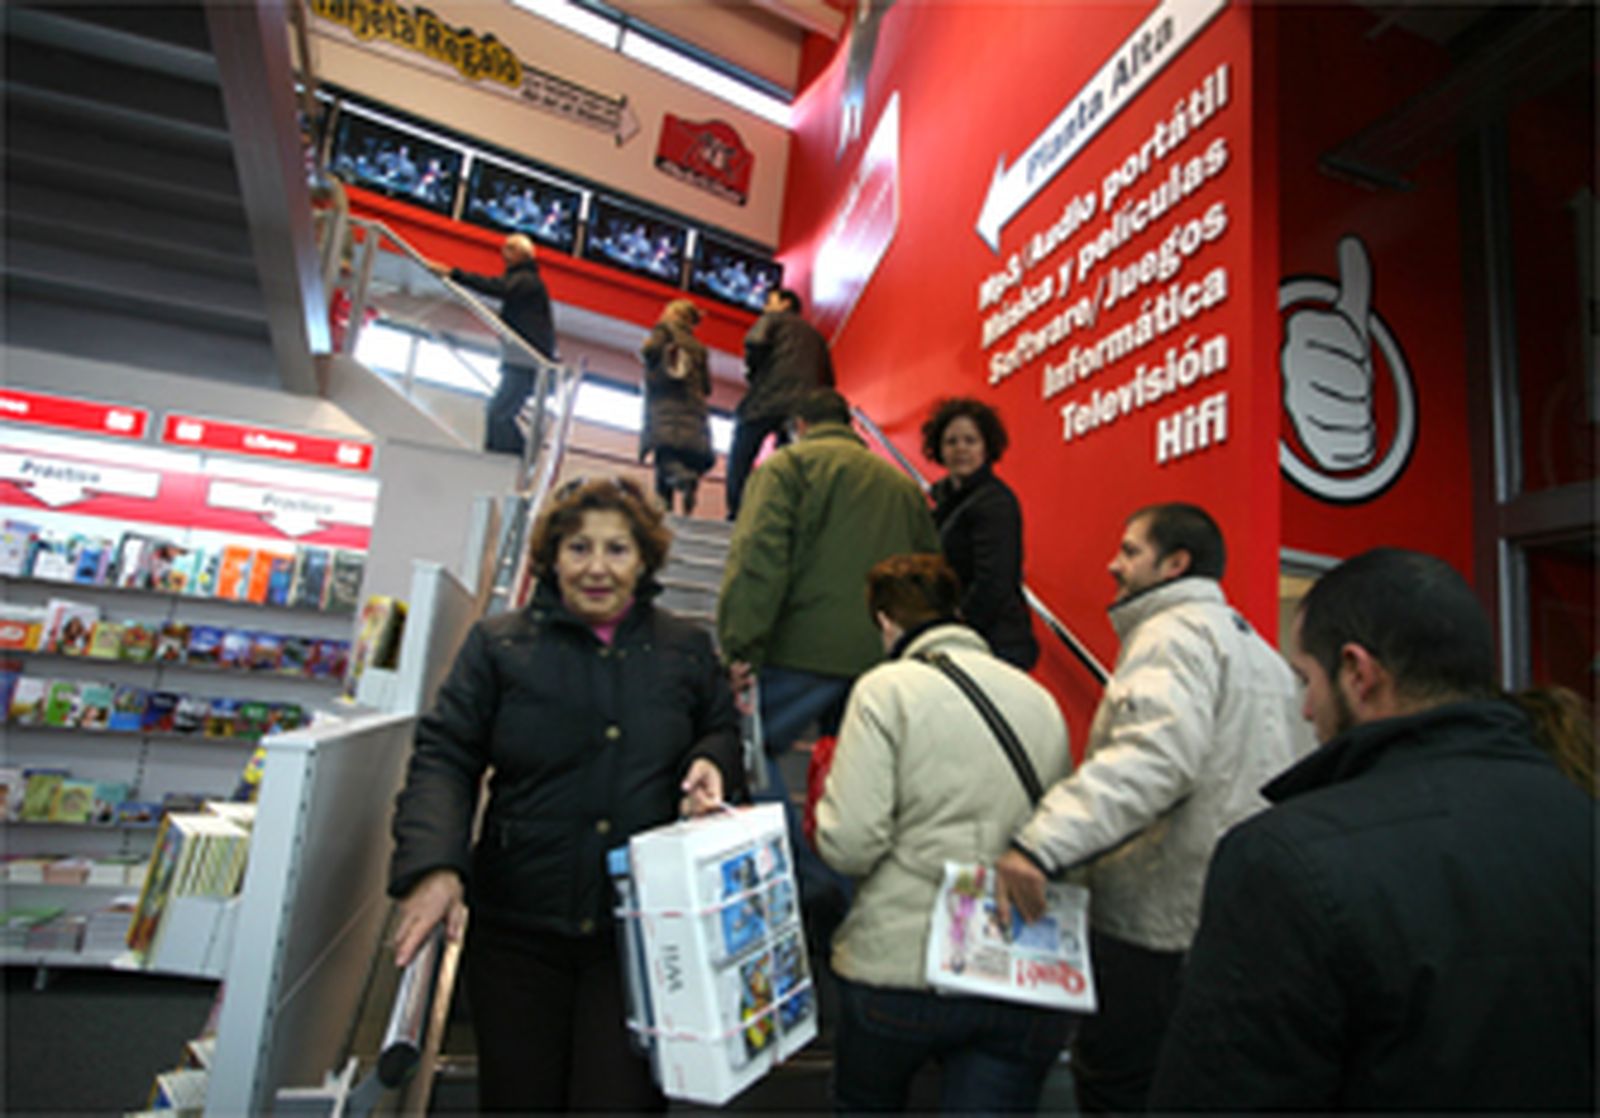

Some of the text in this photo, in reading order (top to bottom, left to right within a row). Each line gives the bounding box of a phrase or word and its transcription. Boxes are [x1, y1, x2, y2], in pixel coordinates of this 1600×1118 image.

[1026, 16, 1174, 184] Planta Alta
[1102, 62, 1229, 212] portátil
[981, 137, 1229, 349] Música y películas
[1043, 267, 1228, 400] Informática
[1060, 334, 1228, 442] Televisión
[1155, 391, 1228, 464] Hifi
